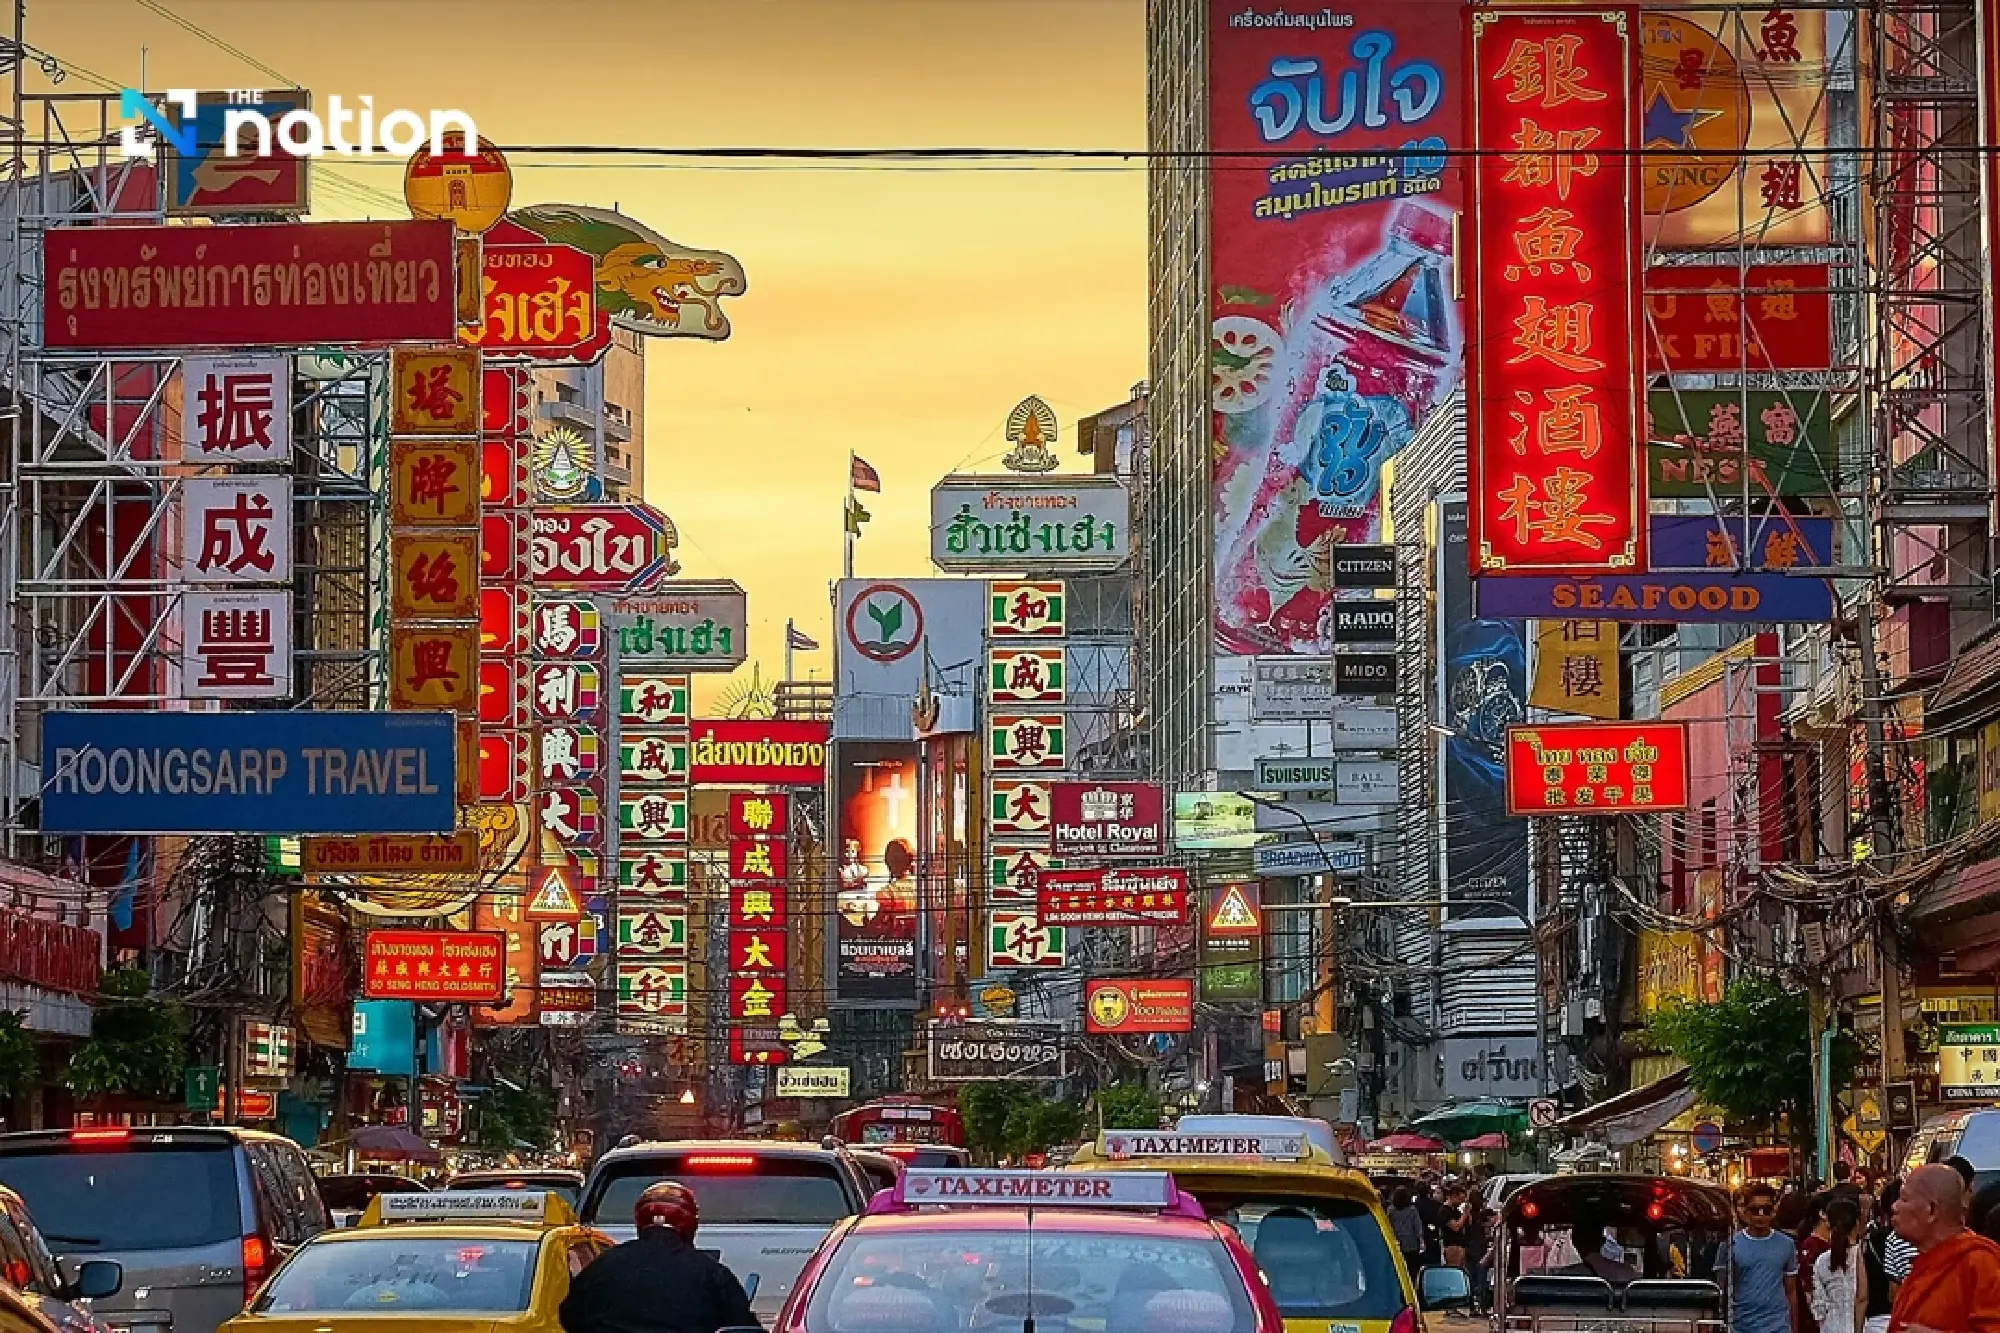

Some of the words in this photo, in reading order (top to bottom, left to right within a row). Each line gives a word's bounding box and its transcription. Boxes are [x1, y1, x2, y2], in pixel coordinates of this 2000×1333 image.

[1250, 31, 1441, 141] จับใจ
[1656, 167, 1720, 186] SING
[58, 228, 441, 337] รุ่งทรัพย์การท่องเที่ยว
[1492, 33, 1615, 548] 銀都魚翅酒樓
[197, 373, 275, 687] 振成豐
[1336, 560, 1393, 576] CITIZEN
[1552, 583, 1761, 612] SEAFOOD
[1338, 611, 1394, 627] RADO
[1345, 664, 1388, 677] MIDO
[55, 748, 288, 795] ROONGSARP
[302, 748, 439, 794] TRAVEL
[1056, 823, 1101, 840] Hotel
[1107, 823, 1158, 842] Royal
[743, 798, 775, 1062] 聯成興大金
[1130, 1137, 1263, 1154] TAXI-METER
[934, 1175, 1113, 1198] TAXI-METER
